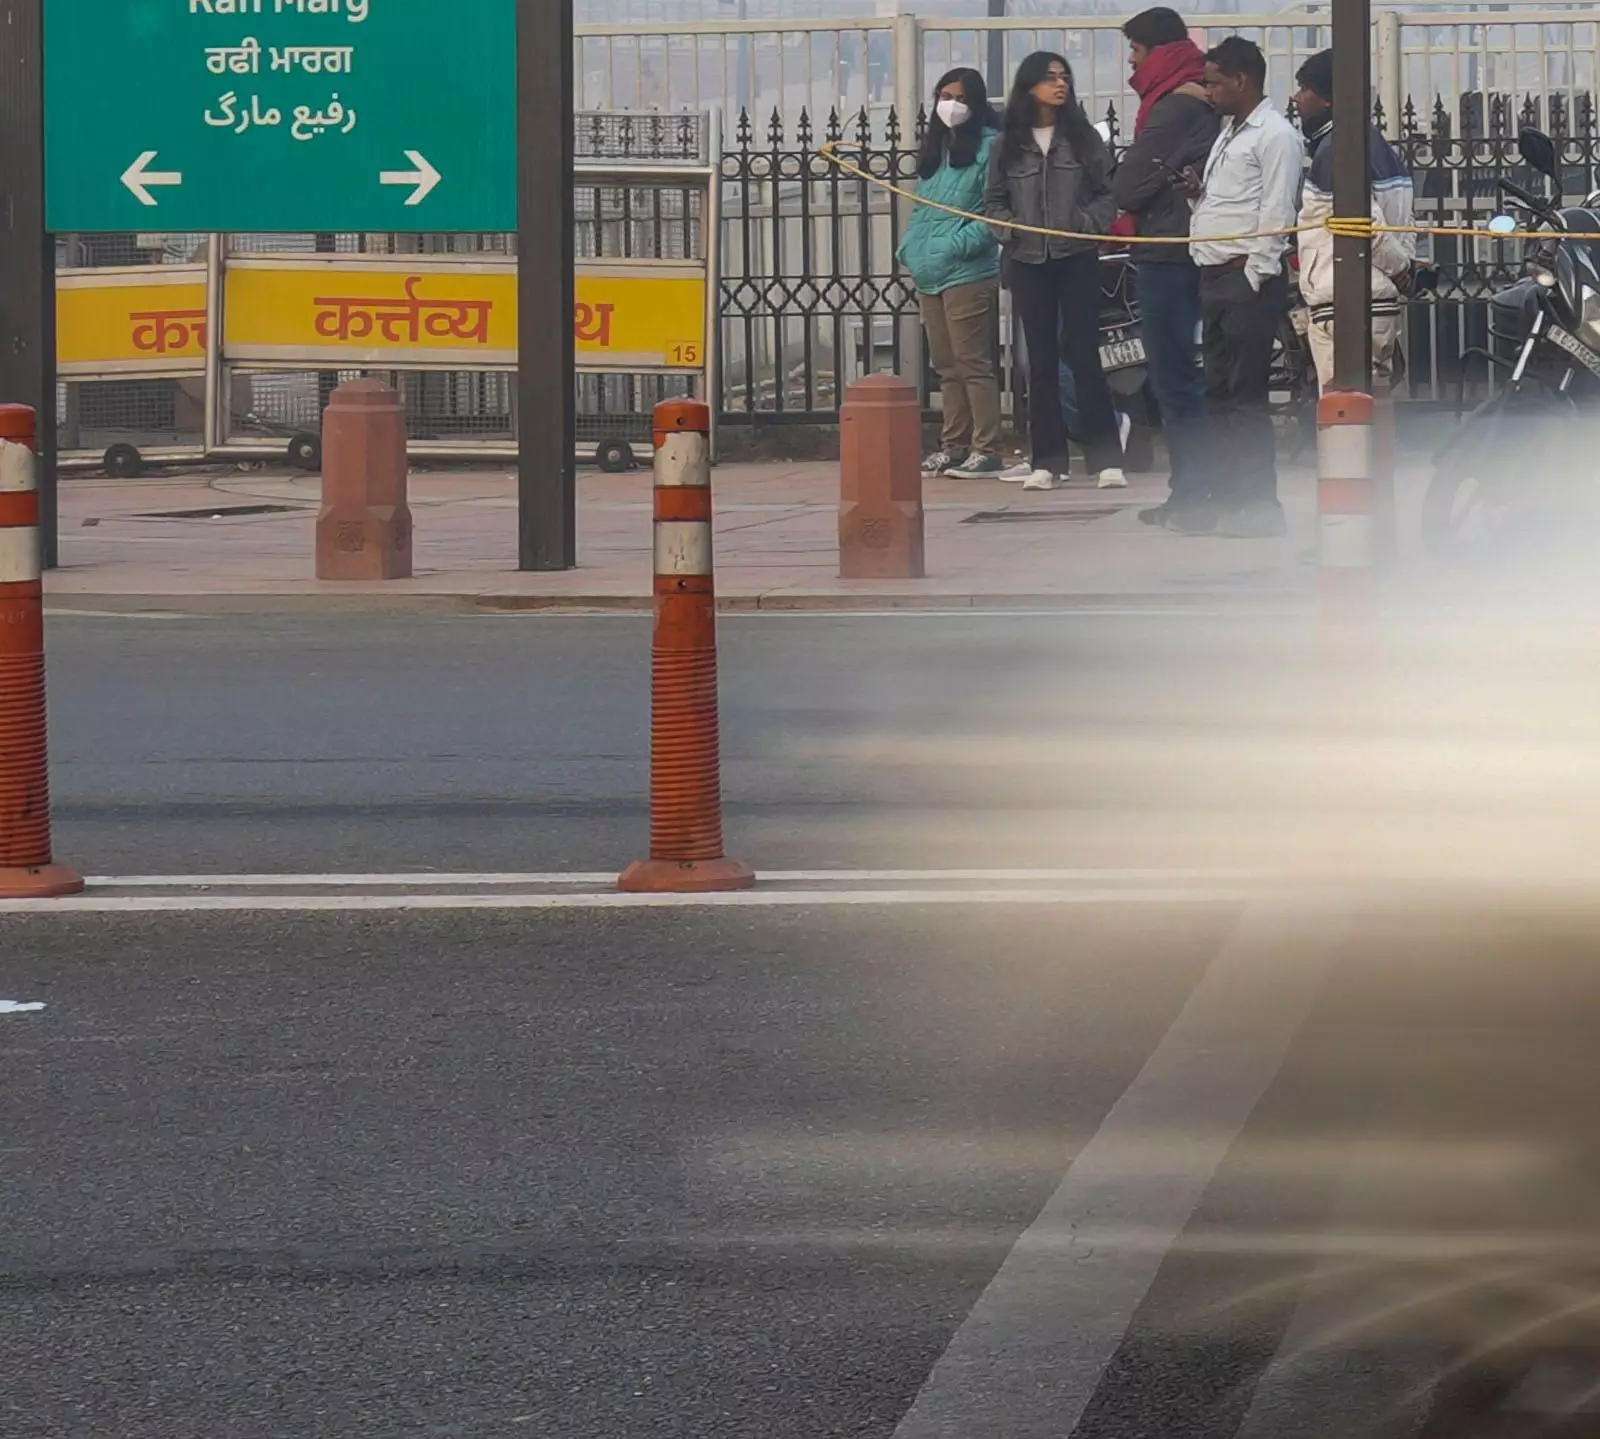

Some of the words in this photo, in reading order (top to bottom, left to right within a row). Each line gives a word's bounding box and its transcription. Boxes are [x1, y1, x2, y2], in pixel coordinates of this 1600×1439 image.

[268, 46, 354, 73] ਮਾਰਗ
[204, 91, 282, 134] مارگ
[672, 345, 697, 362] 15
